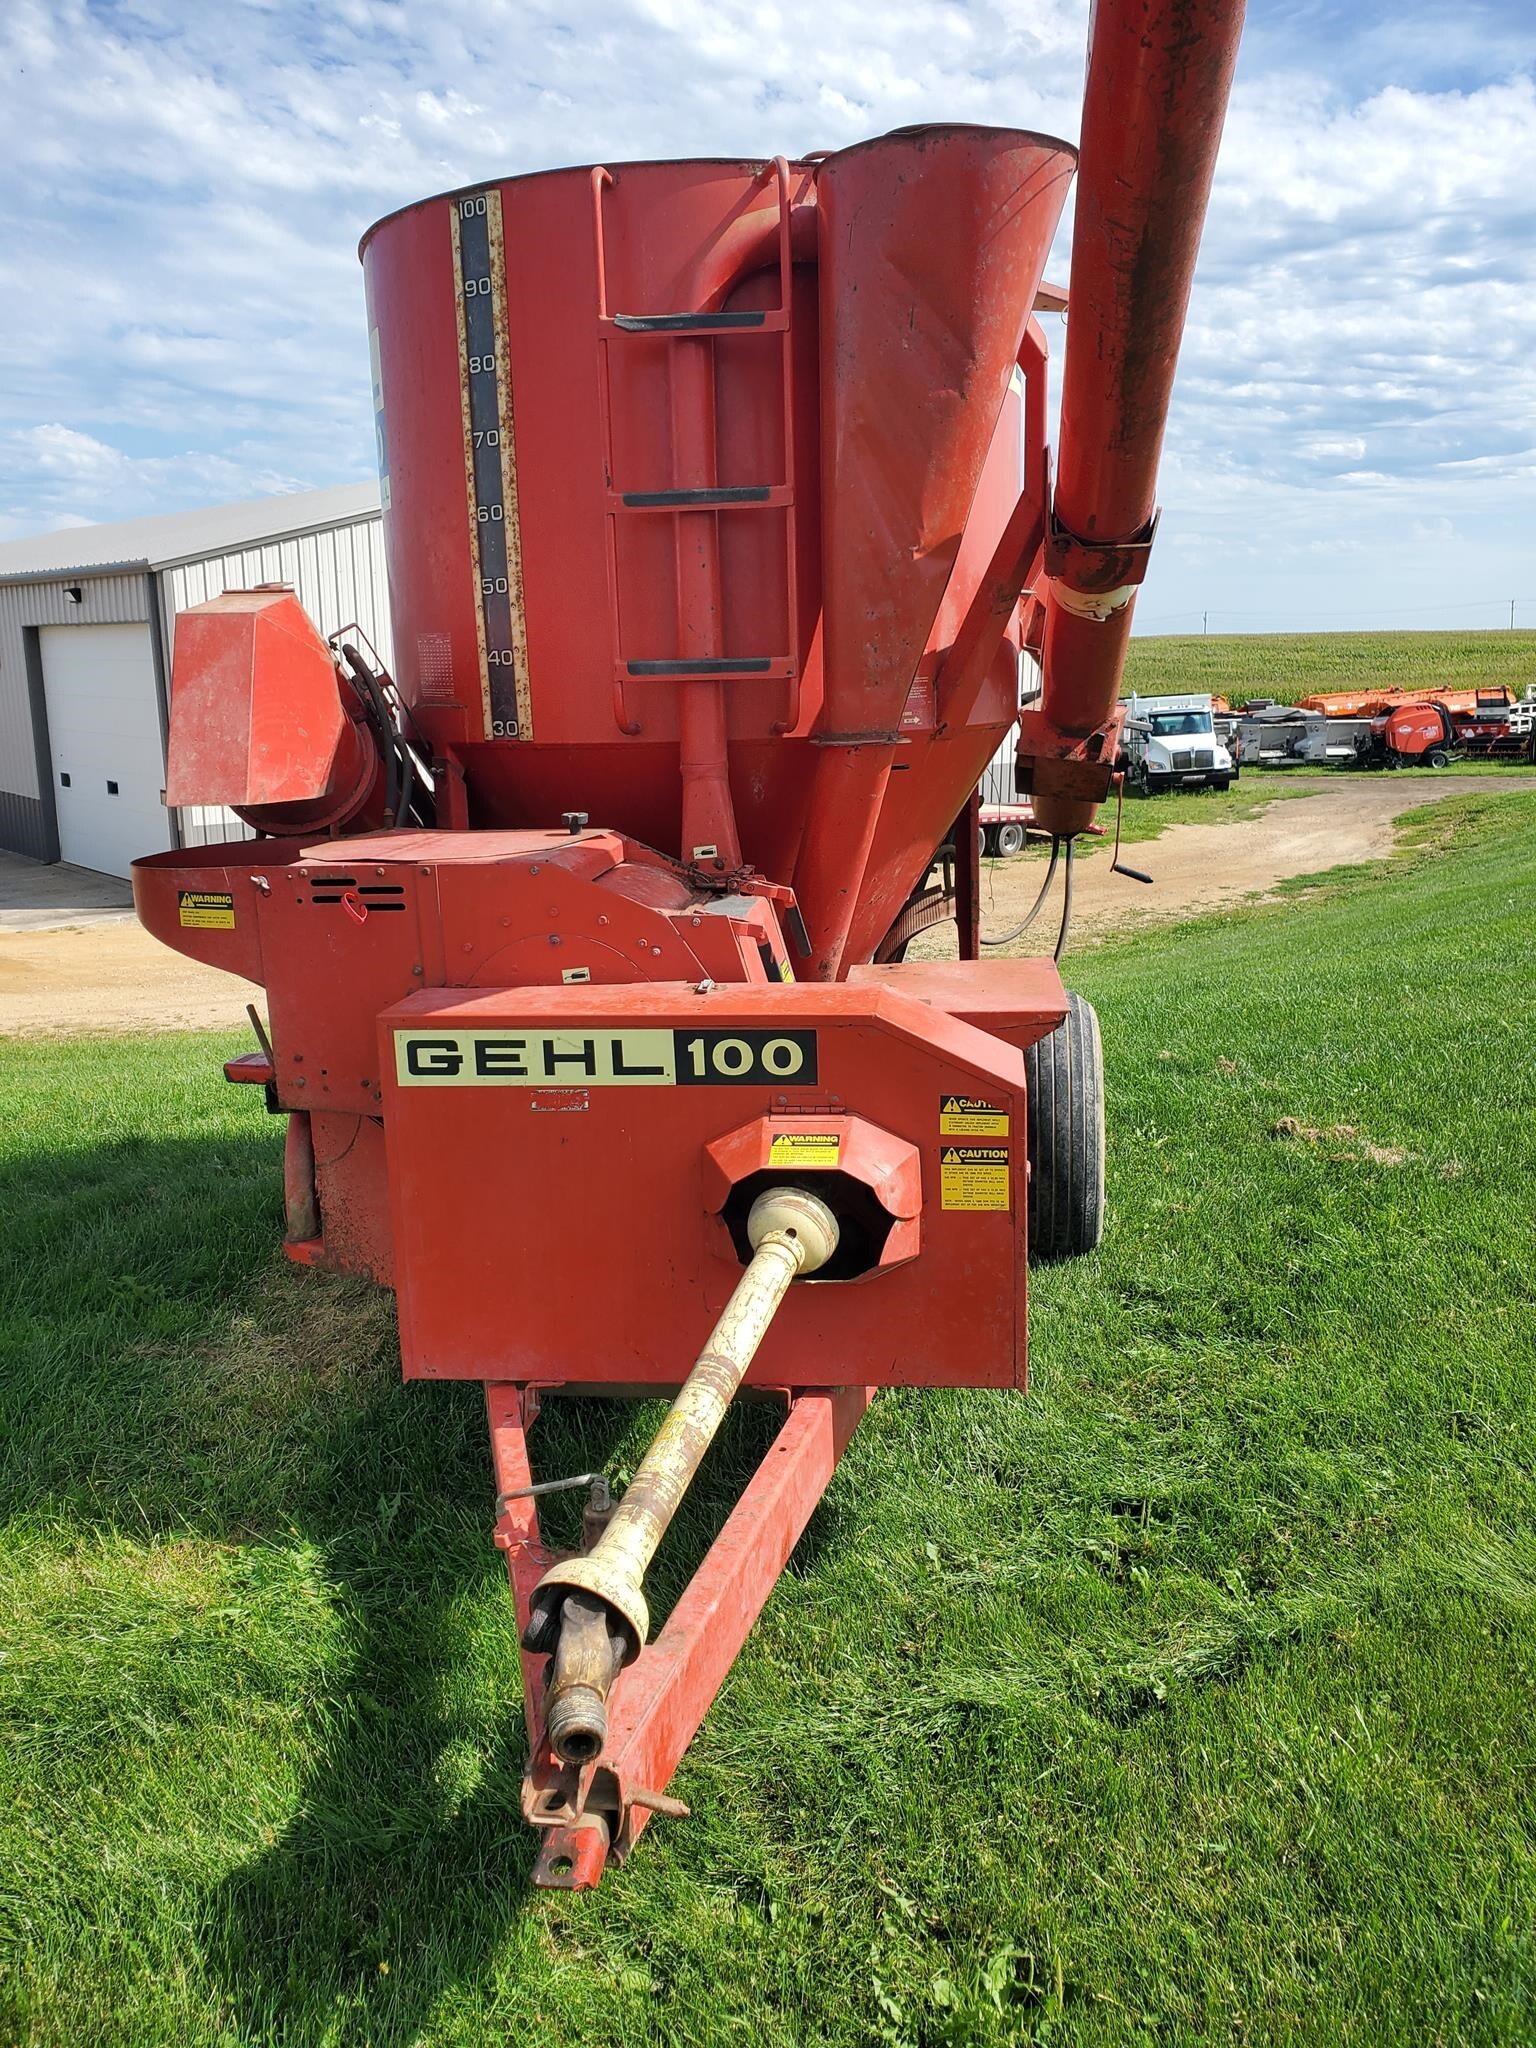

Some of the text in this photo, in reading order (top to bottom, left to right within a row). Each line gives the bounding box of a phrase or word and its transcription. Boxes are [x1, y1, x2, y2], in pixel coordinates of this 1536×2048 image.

[459, 197, 487, 220] 100
[464, 277, 491, 298] 90
[469, 354, 496, 374] 80
[473, 430, 499, 448] 70
[477, 504, 503, 522] 60
[482, 577, 508, 595] 50
[487, 650, 513, 667] 40
[493, 720, 518, 737] 30
[190, 894, 232, 904] WARNING
[406, 1038, 803, 1077] GEHL 100
[959, 1149, 1008, 1159] CAUTION
